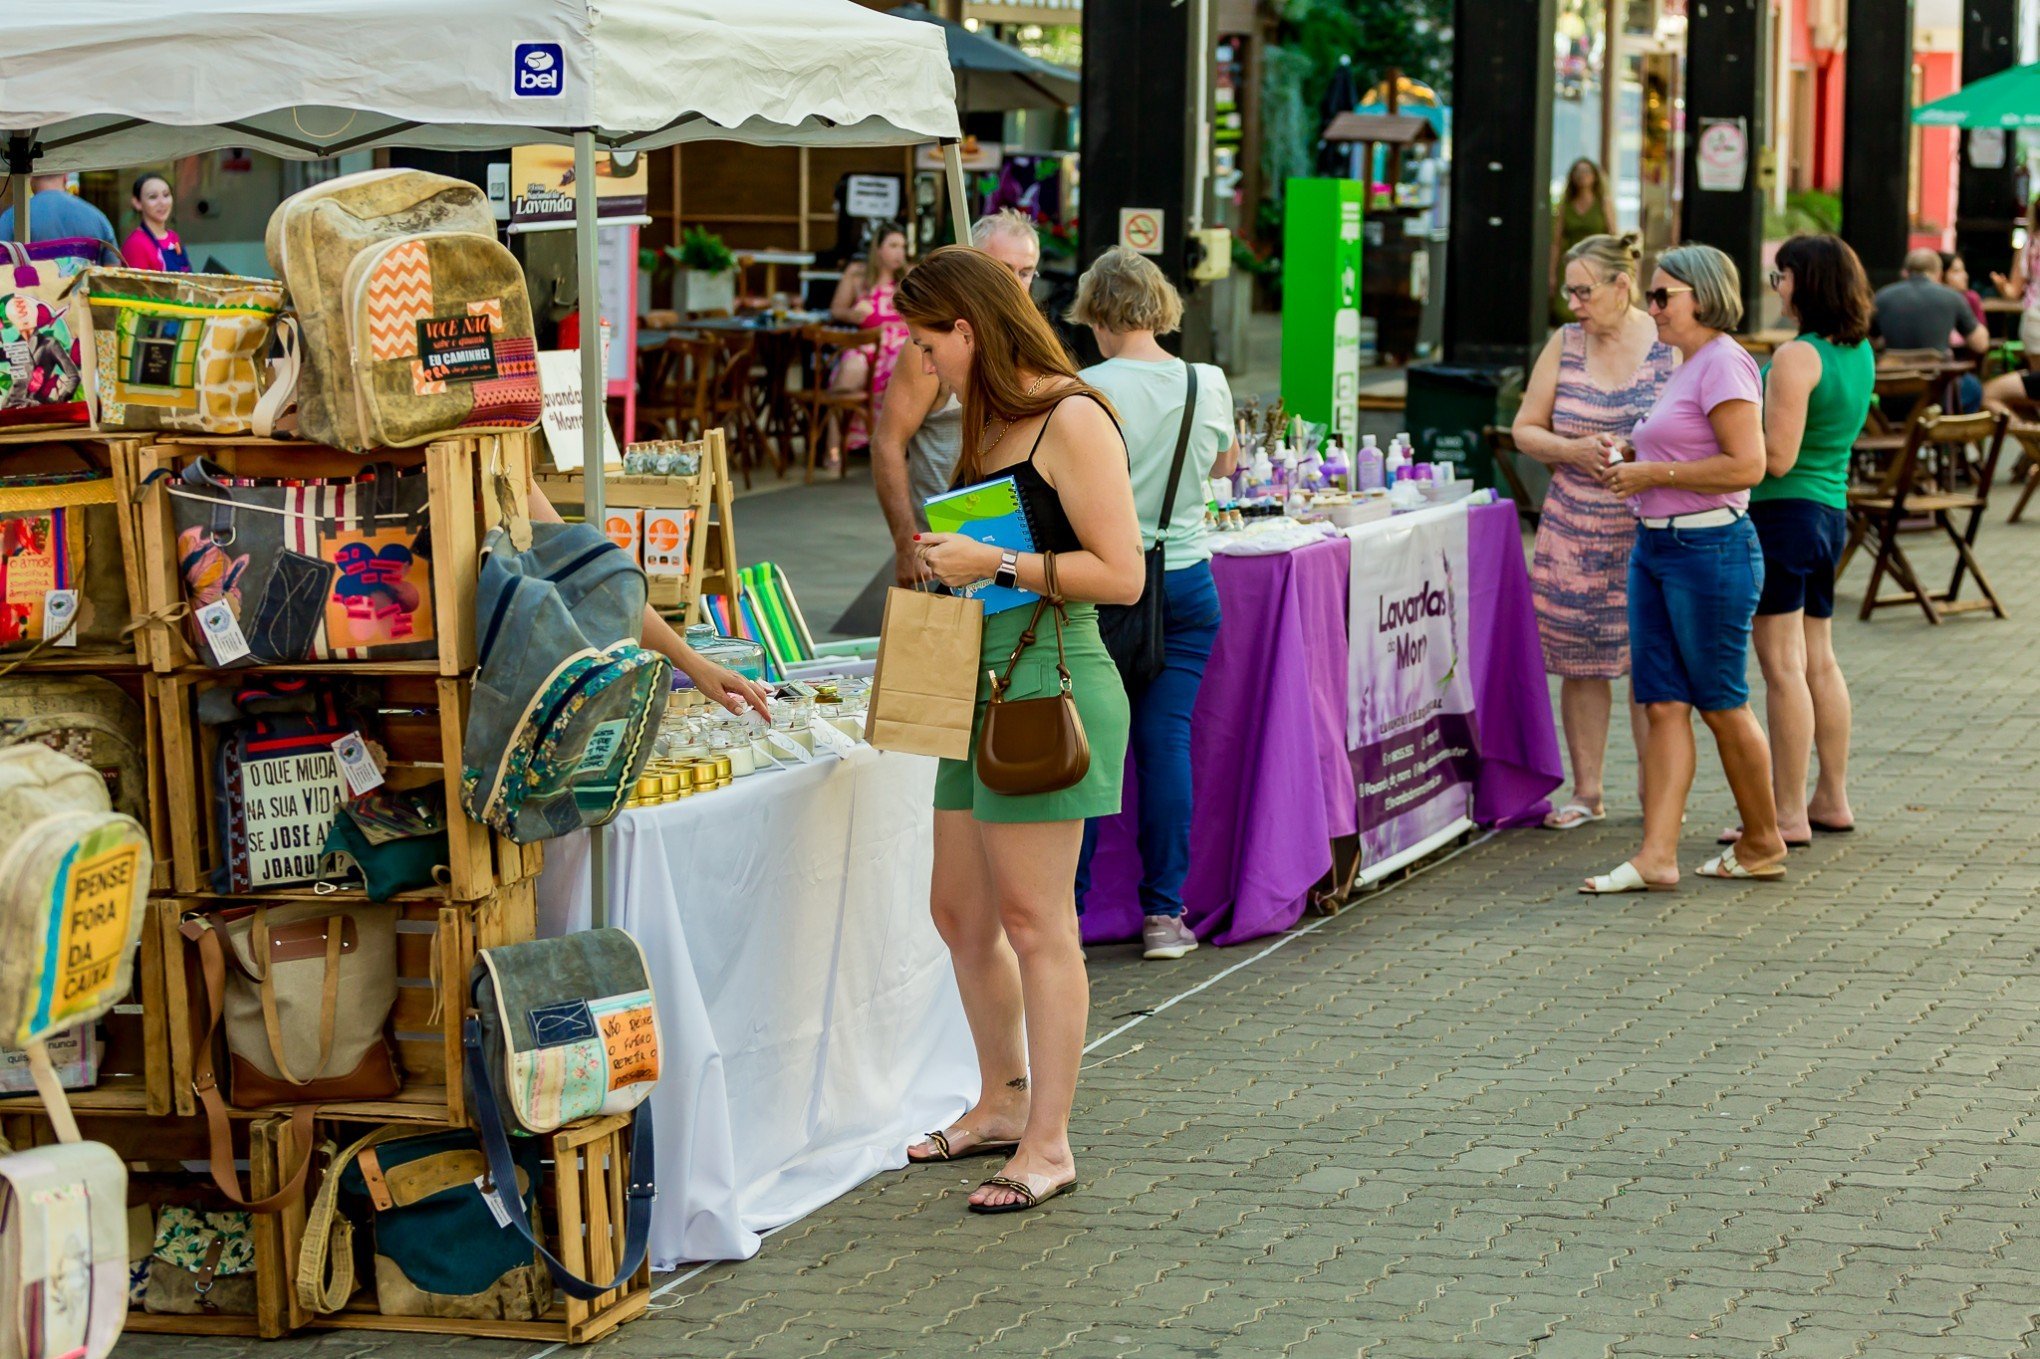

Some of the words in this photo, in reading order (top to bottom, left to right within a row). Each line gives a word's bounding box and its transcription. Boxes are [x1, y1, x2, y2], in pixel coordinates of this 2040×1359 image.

[520, 69, 558, 89] bel
[515, 194, 573, 215] Lavanda
[428, 353, 442, 366] EU
[443, 348, 490, 365] CAMINHEI
[424, 364, 450, 382] PRA
[544, 385, 582, 407] avanda
[250, 763, 260, 787] O
[263, 760, 292, 785] QUE
[296, 756, 338, 782] MUDA
[246, 799, 266, 821] NA
[270, 795, 298, 818] SUA
[302, 785, 342, 815] VIDA
[249, 831, 266, 852] SE
[76, 861, 129, 901] PENSE
[71, 900, 116, 934] FORA
[68, 942, 92, 968] DA
[48, 1039, 78, 1049] nunca
